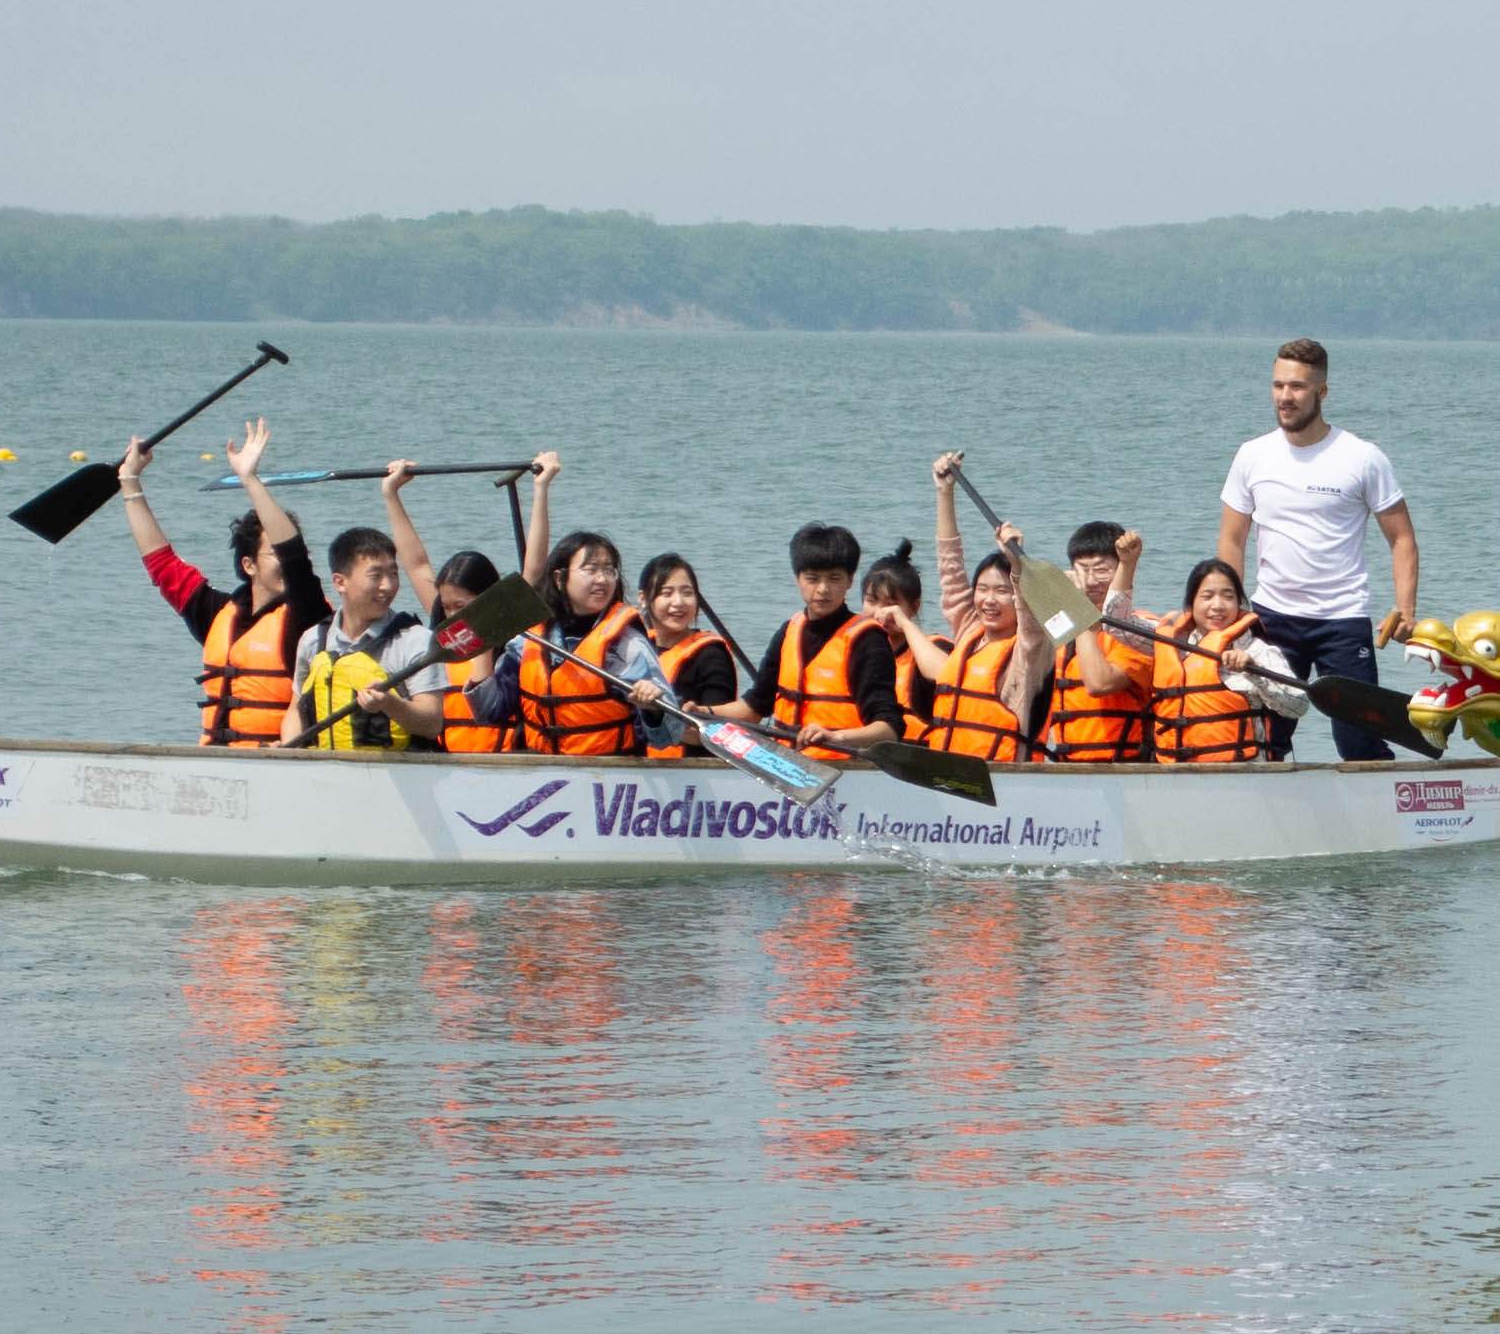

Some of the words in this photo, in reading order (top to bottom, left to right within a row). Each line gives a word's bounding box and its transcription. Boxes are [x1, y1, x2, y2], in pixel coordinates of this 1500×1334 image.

[592, 782, 848, 839] Vladivostok
[857, 812, 1011, 844] International
[1019, 817, 1101, 854] Airport
[1414, 817, 1462, 827] AEROFLOT
